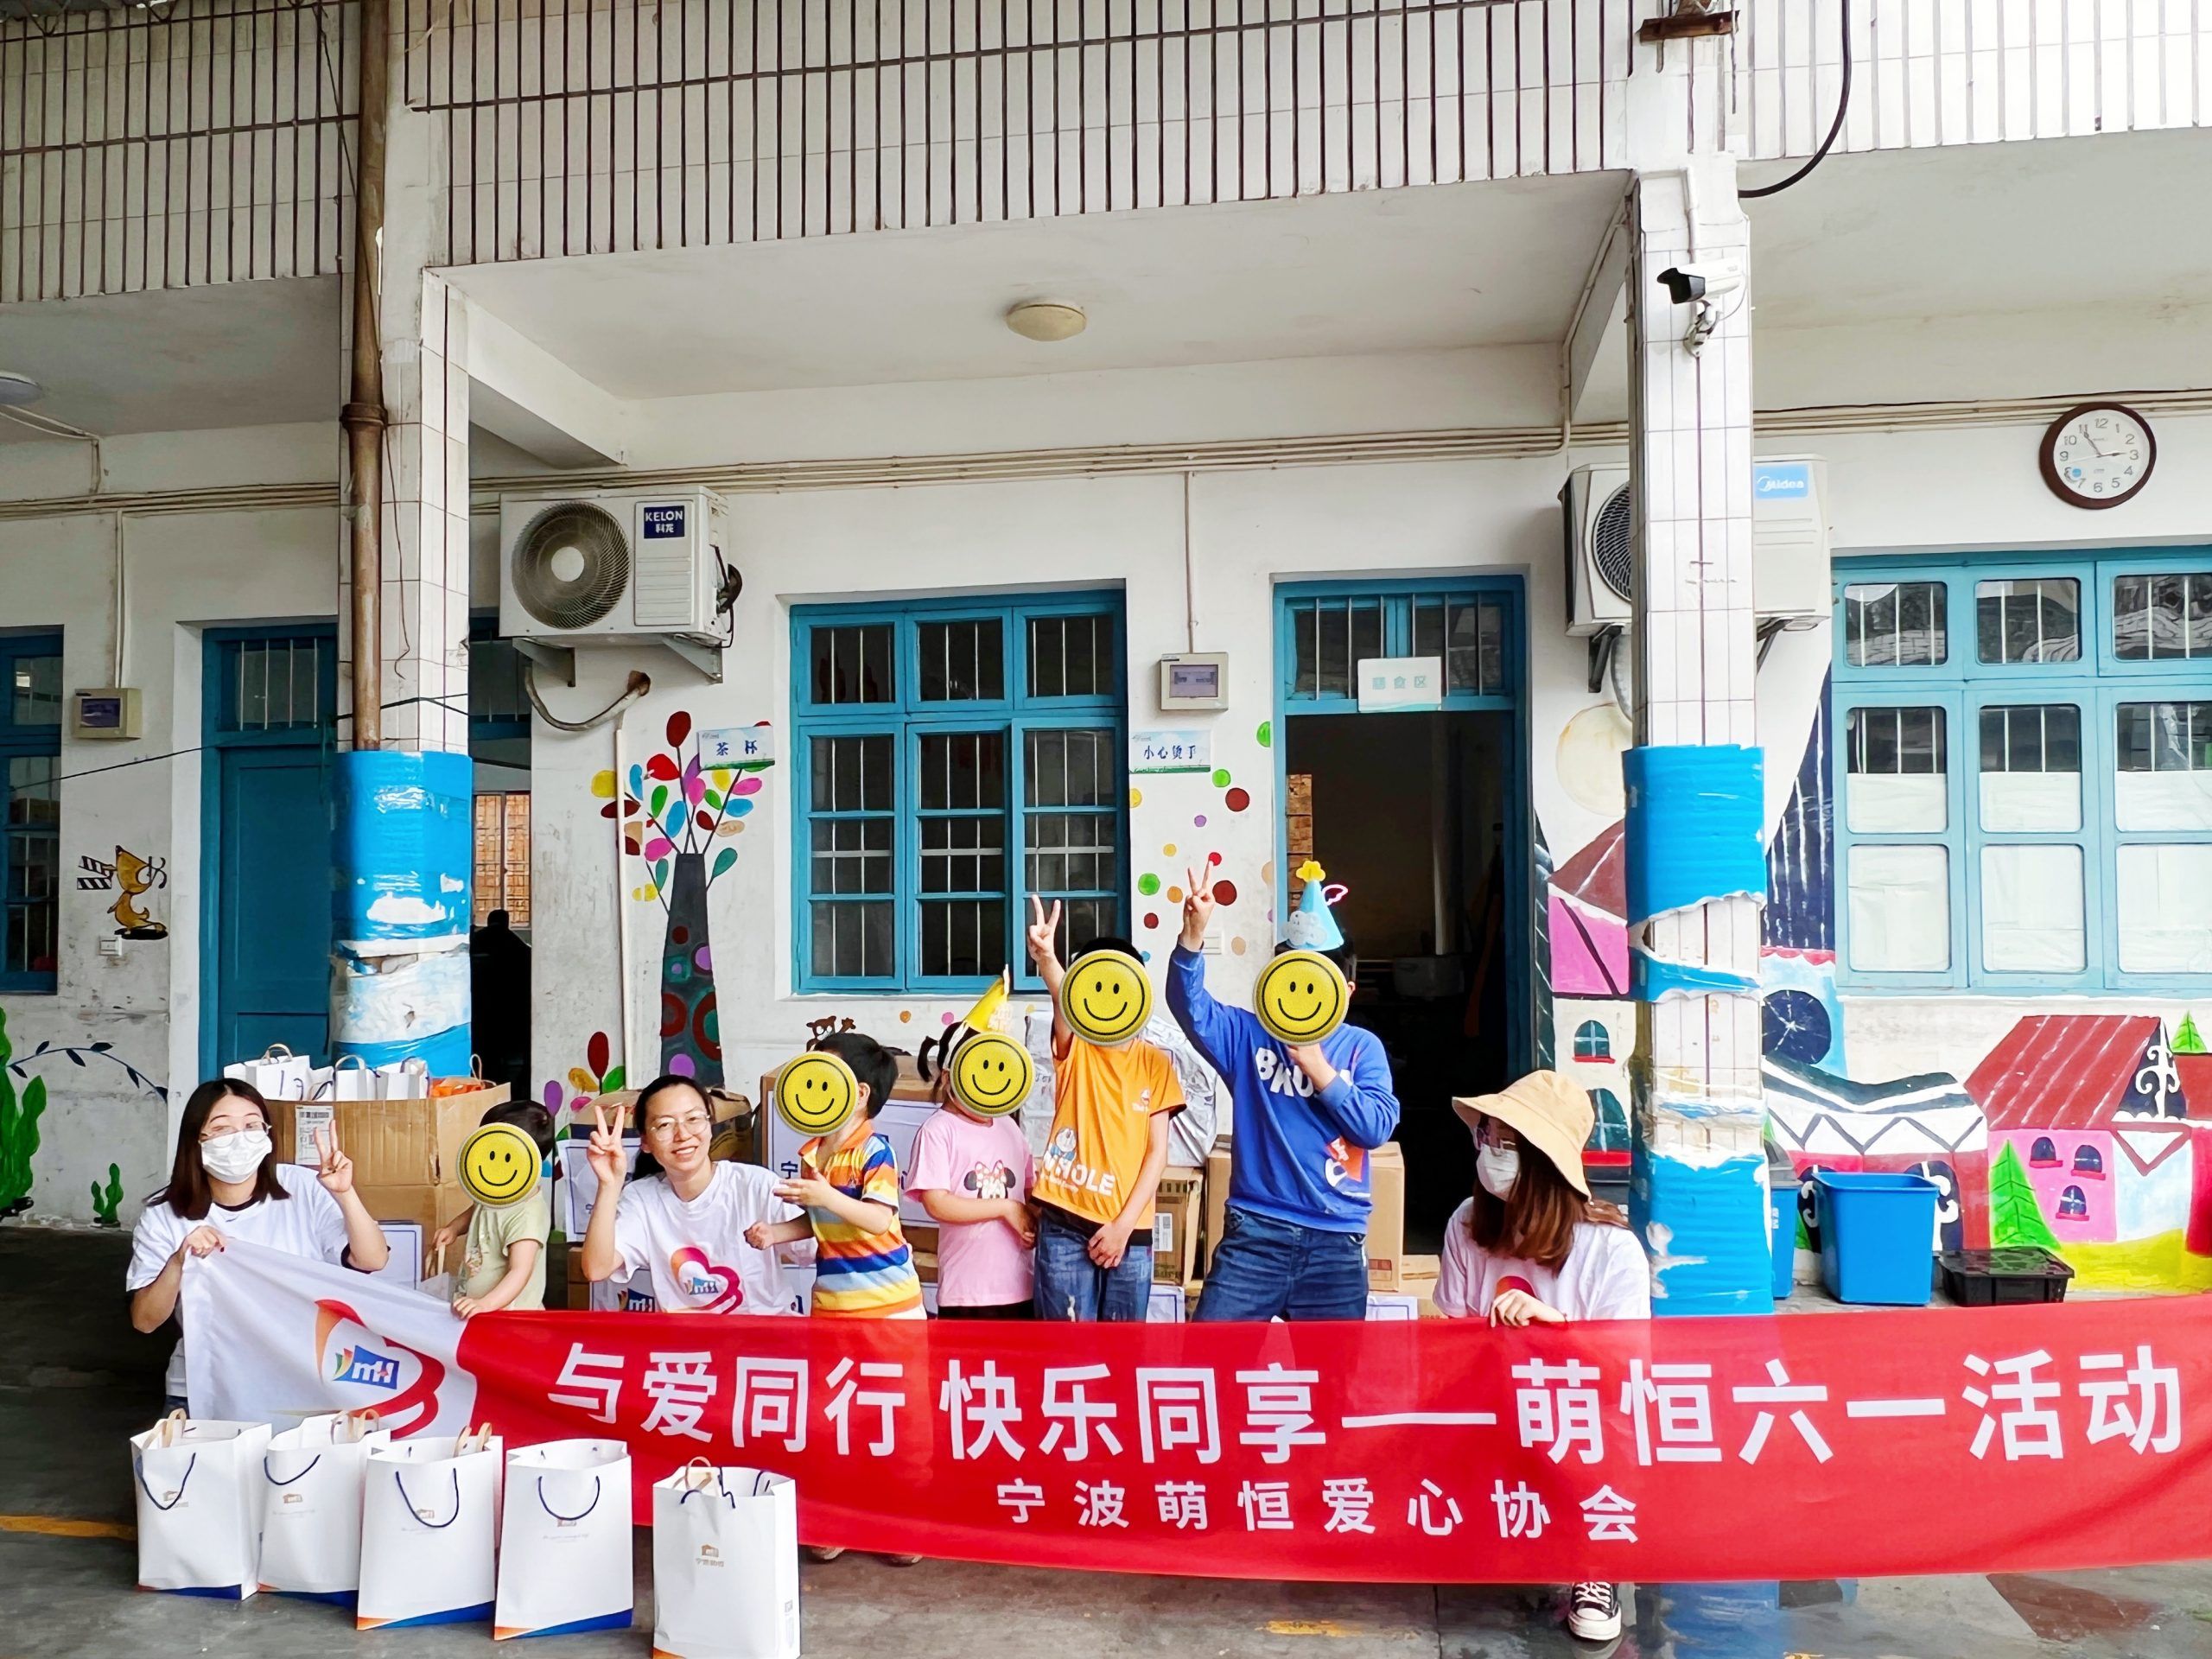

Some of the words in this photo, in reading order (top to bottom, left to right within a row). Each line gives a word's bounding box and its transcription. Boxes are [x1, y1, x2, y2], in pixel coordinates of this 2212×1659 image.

[2094, 417, 2109, 429] 12
[2063, 435, 2078, 446] 10
[2125, 433, 2135, 445] 2
[2059, 450, 2069, 462] 9
[2129, 449, 2139, 461] 3
[2123, 466, 2133, 476] 4
[1764, 477, 1805, 490] Midea
[2093, 481, 2103, 493] 6
[2111, 477, 2121, 489] 5
[645, 510, 683, 522] KELON
[548, 1342, 906, 1457] 与爱同行
[996, 1478, 1639, 1544] 宁波萌恒爱心协会
